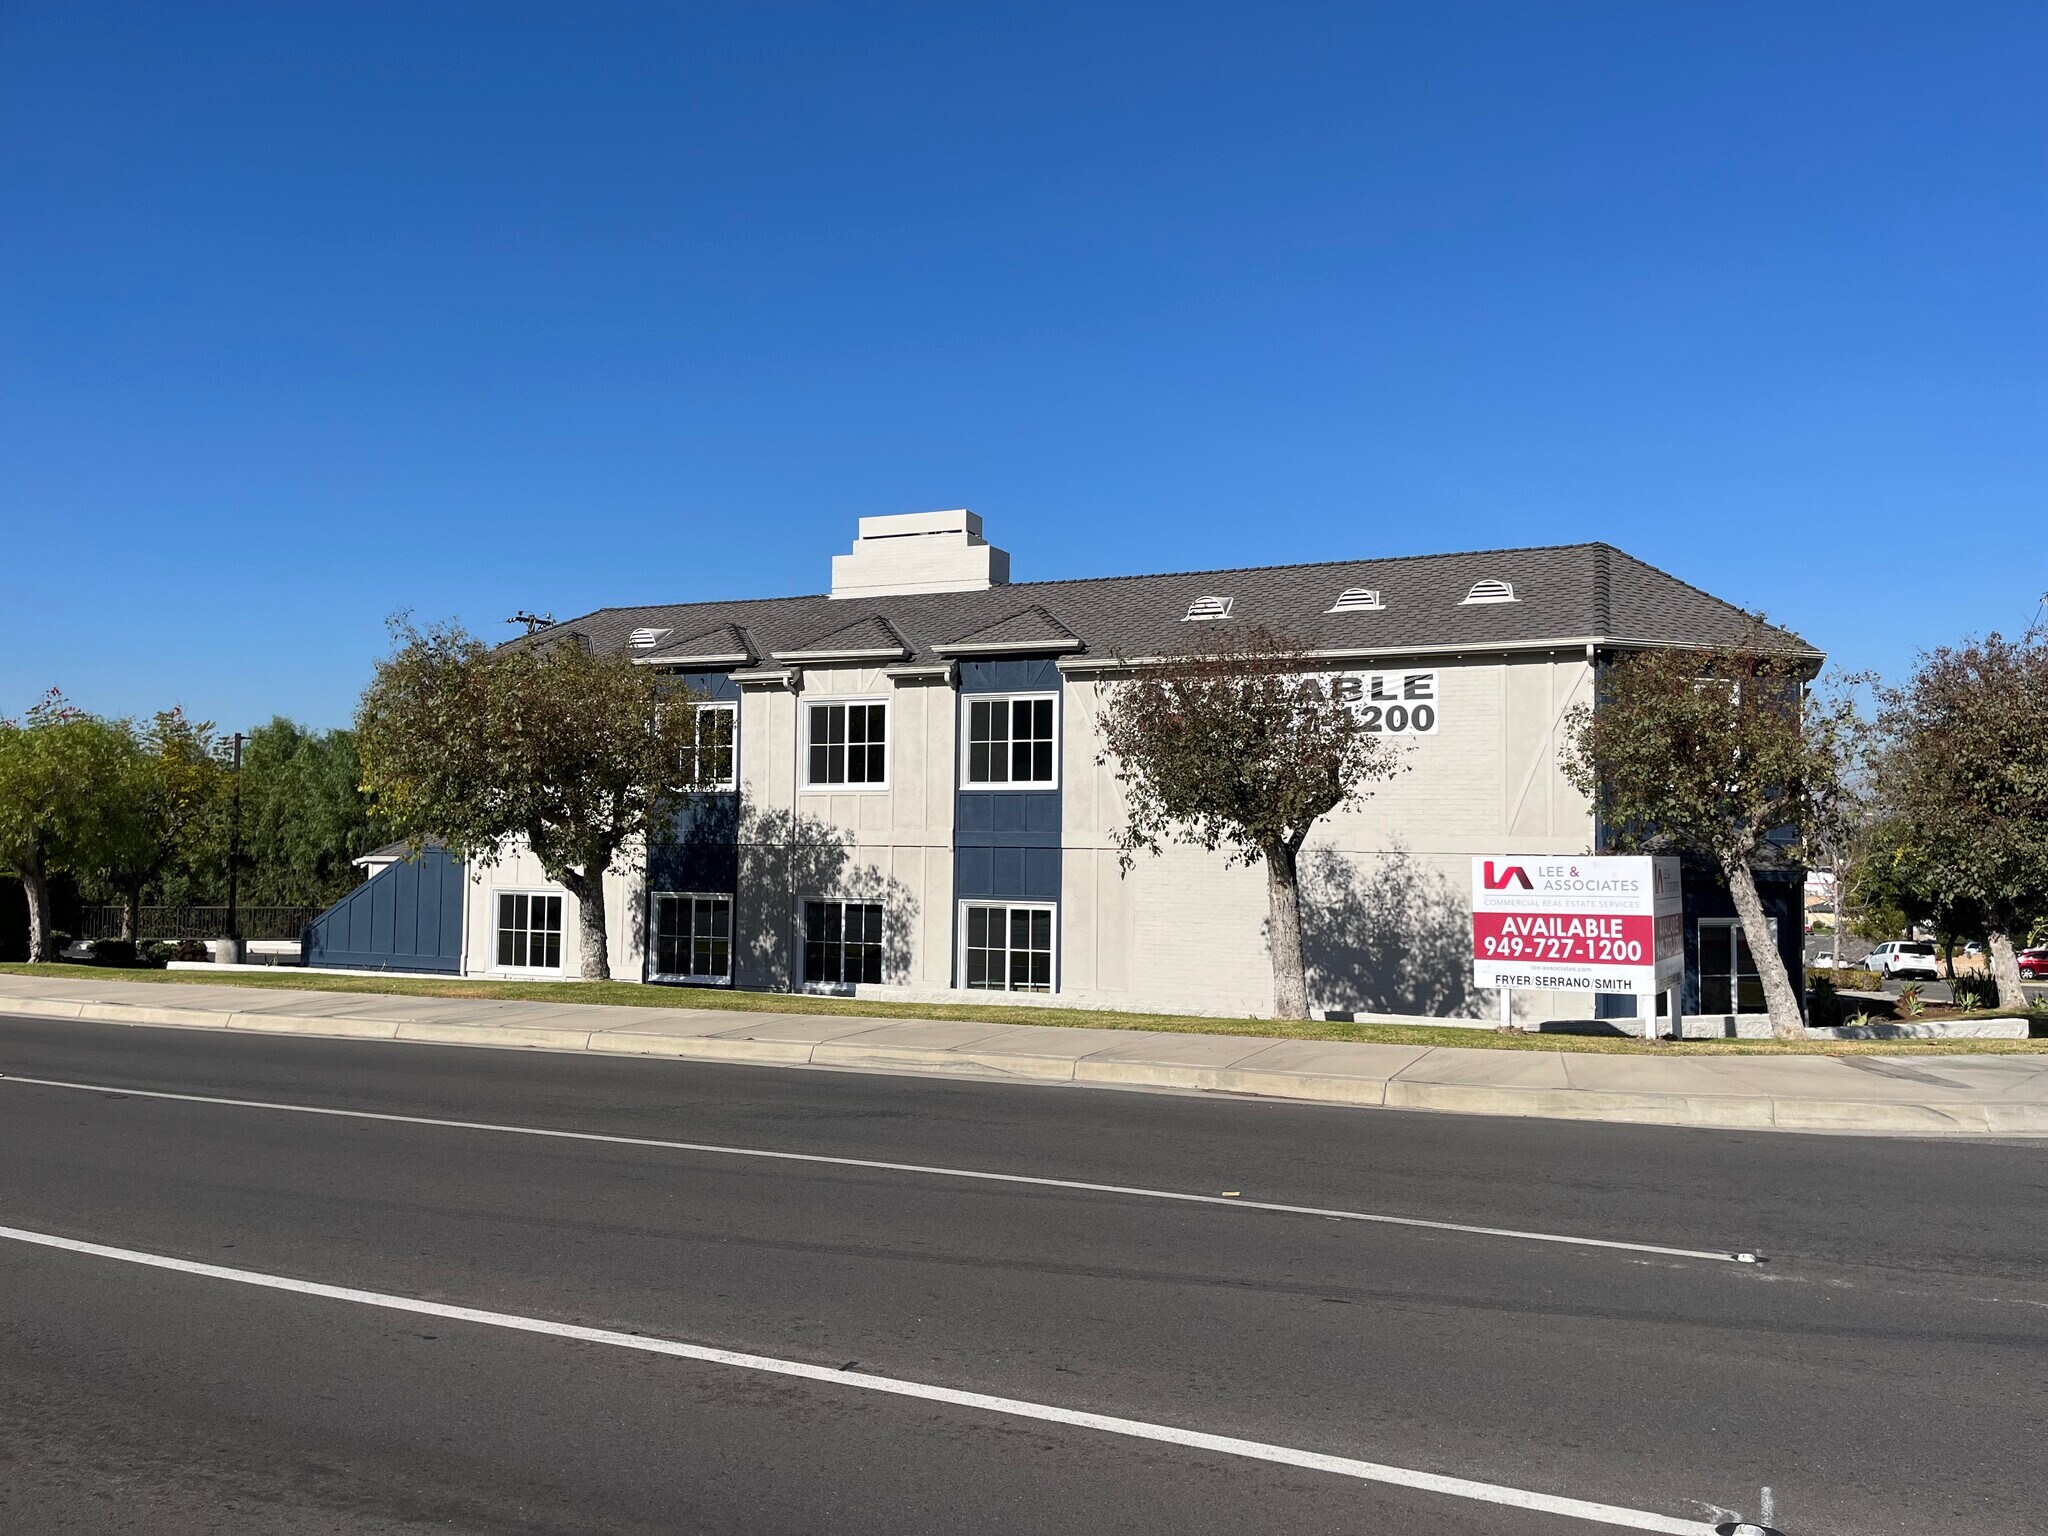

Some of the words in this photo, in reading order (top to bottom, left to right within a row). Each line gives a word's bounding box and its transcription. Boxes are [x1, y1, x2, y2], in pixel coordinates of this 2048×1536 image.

[1538, 866, 1564, 877] LEE
[1569, 866, 1580, 877] &
[1544, 880, 1639, 892] ASSOCIATES
[1483, 898, 1540, 908] COMMERCIAL
[1542, 899, 1563, 908] REAL
[1565, 900, 1596, 908] ESTATE
[1598, 900, 1641, 909] SERVICES
[1501, 916, 1623, 938] AVAILABLE
[1483, 936, 1642, 961] 949-727-1200
[1530, 964, 1593, 973] lee-associates.com
